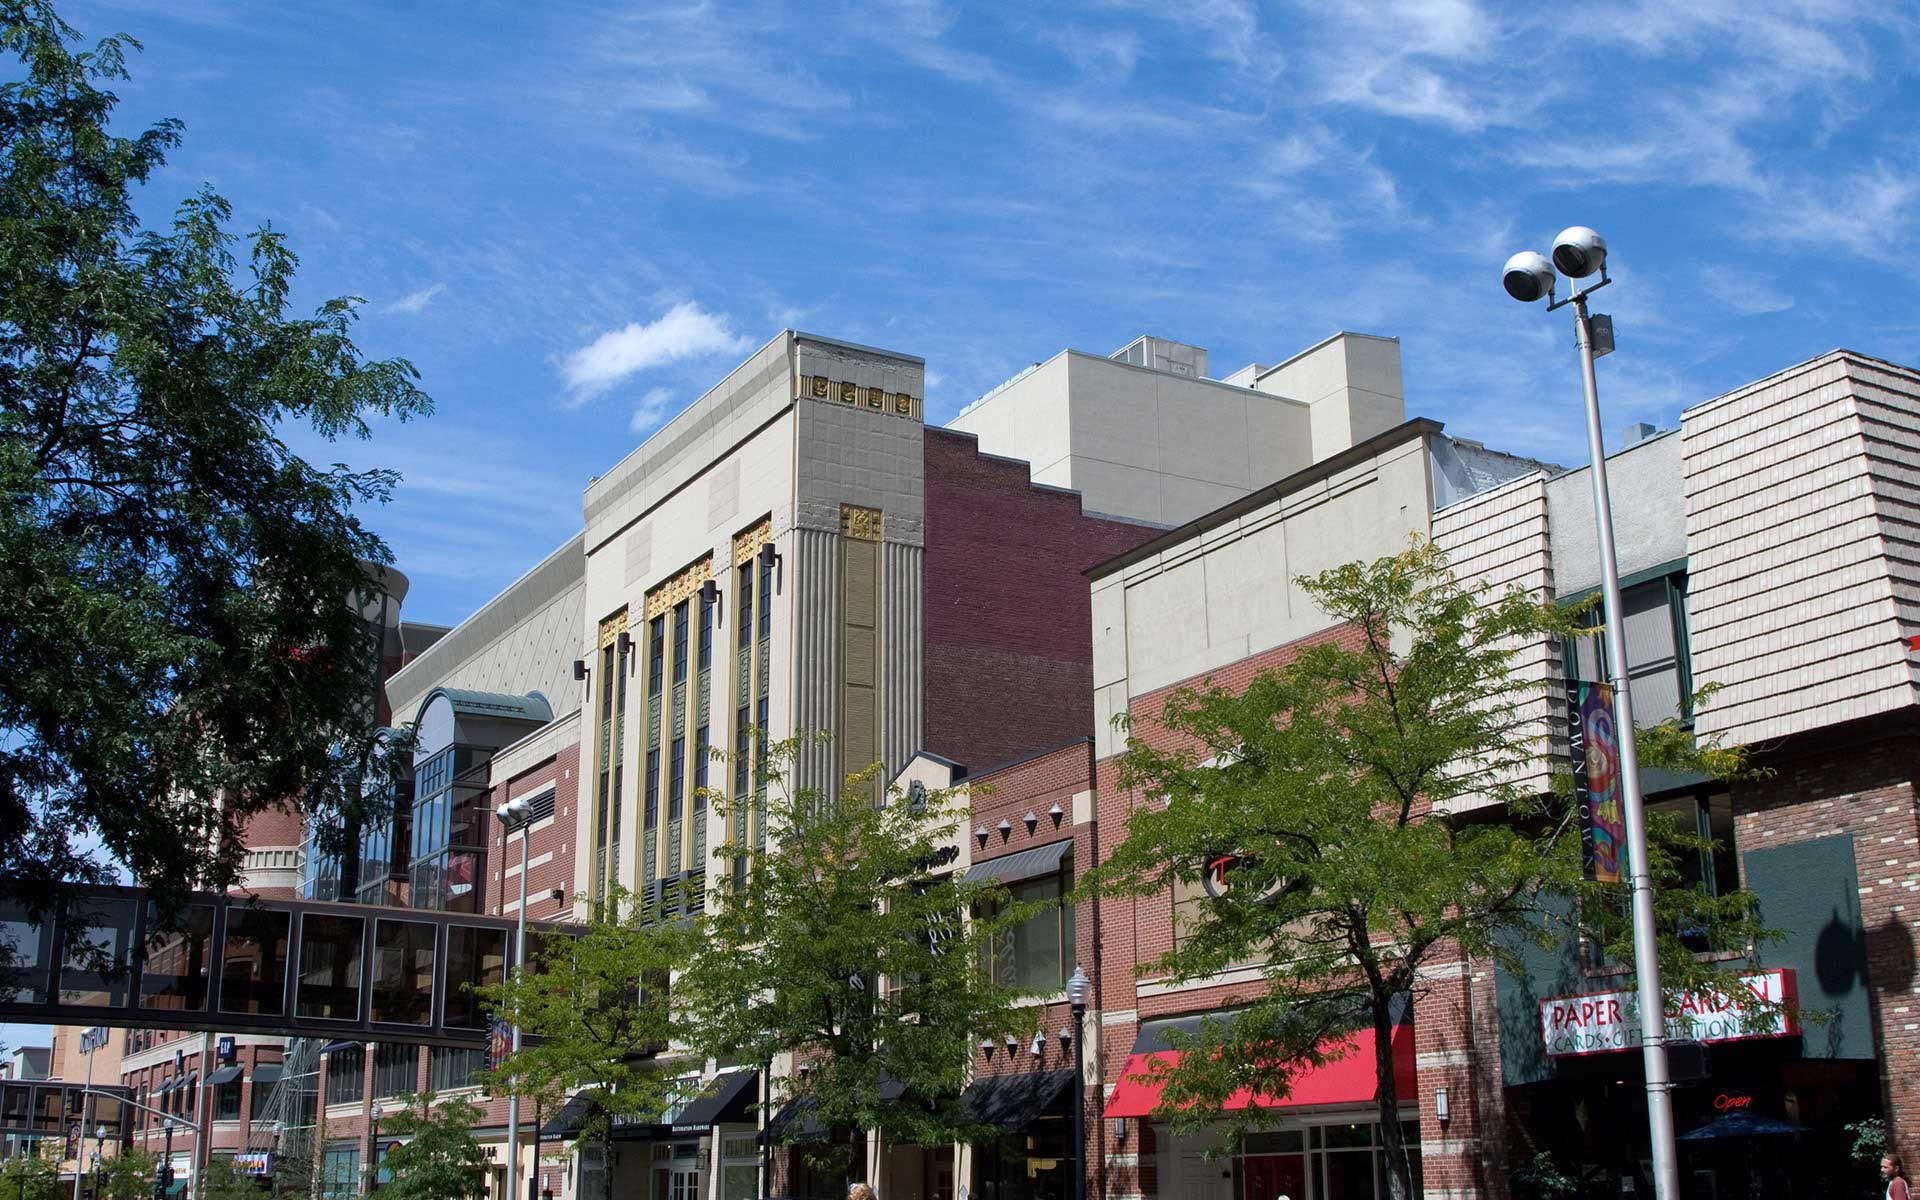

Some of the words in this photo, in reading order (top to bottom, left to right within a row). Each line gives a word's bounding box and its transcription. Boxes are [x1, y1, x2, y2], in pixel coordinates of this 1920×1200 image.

[1566, 688, 1595, 871] DOWNTOWN
[1553, 999, 1622, 1030] PAPER
[1554, 1032, 1603, 1052] CARDS
[1612, 1028, 1643, 1047] GIFT
[1714, 1094, 1751, 1112] Open
